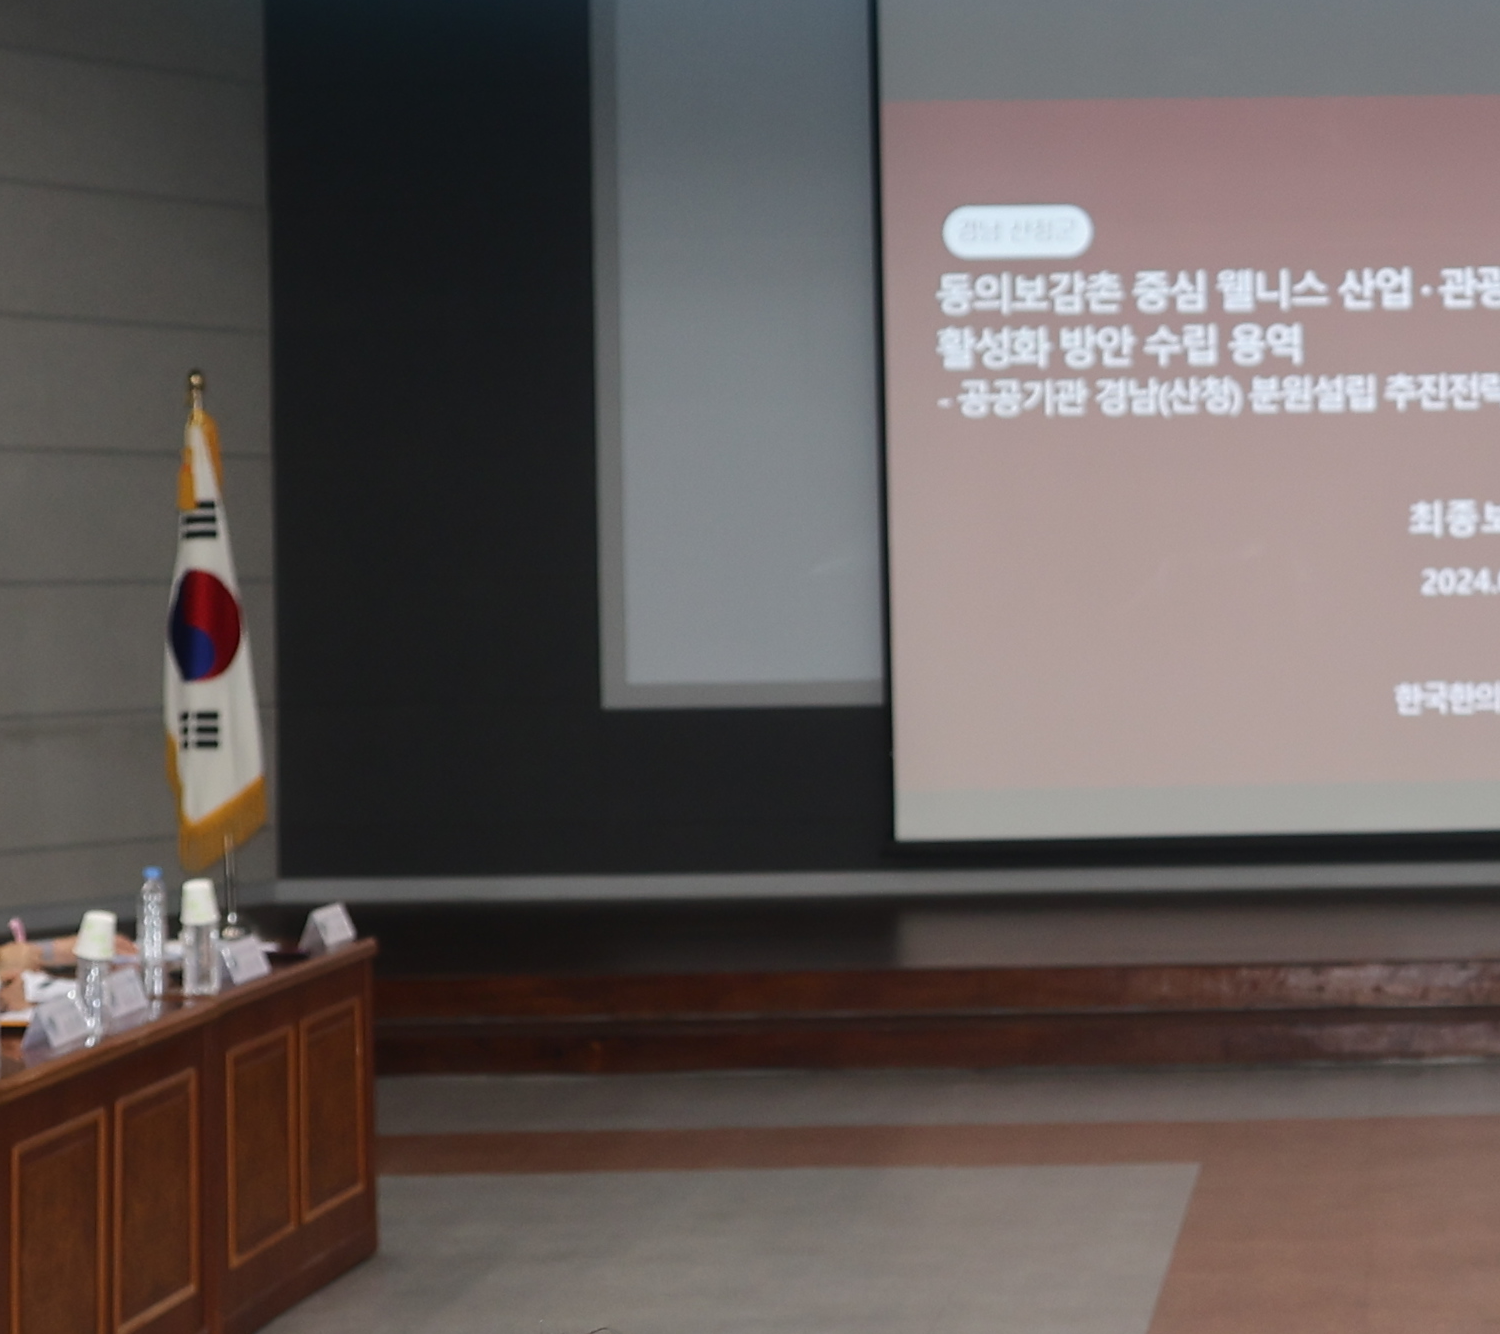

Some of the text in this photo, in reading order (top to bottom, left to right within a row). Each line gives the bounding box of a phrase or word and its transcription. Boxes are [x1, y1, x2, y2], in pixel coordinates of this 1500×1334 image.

[936, 270, 1126, 316] 동의보감촌
[1131, 268, 1208, 314] 중심
[1215, 267, 1331, 313] 웰니스
[936, 321, 1305, 371] 활성화 방안 수립 용역
[956, 377, 1091, 418] 공공기관
[1095, 375, 1244, 419] 경남(산청)
[1248, 372, 1378, 415] 분원설립
